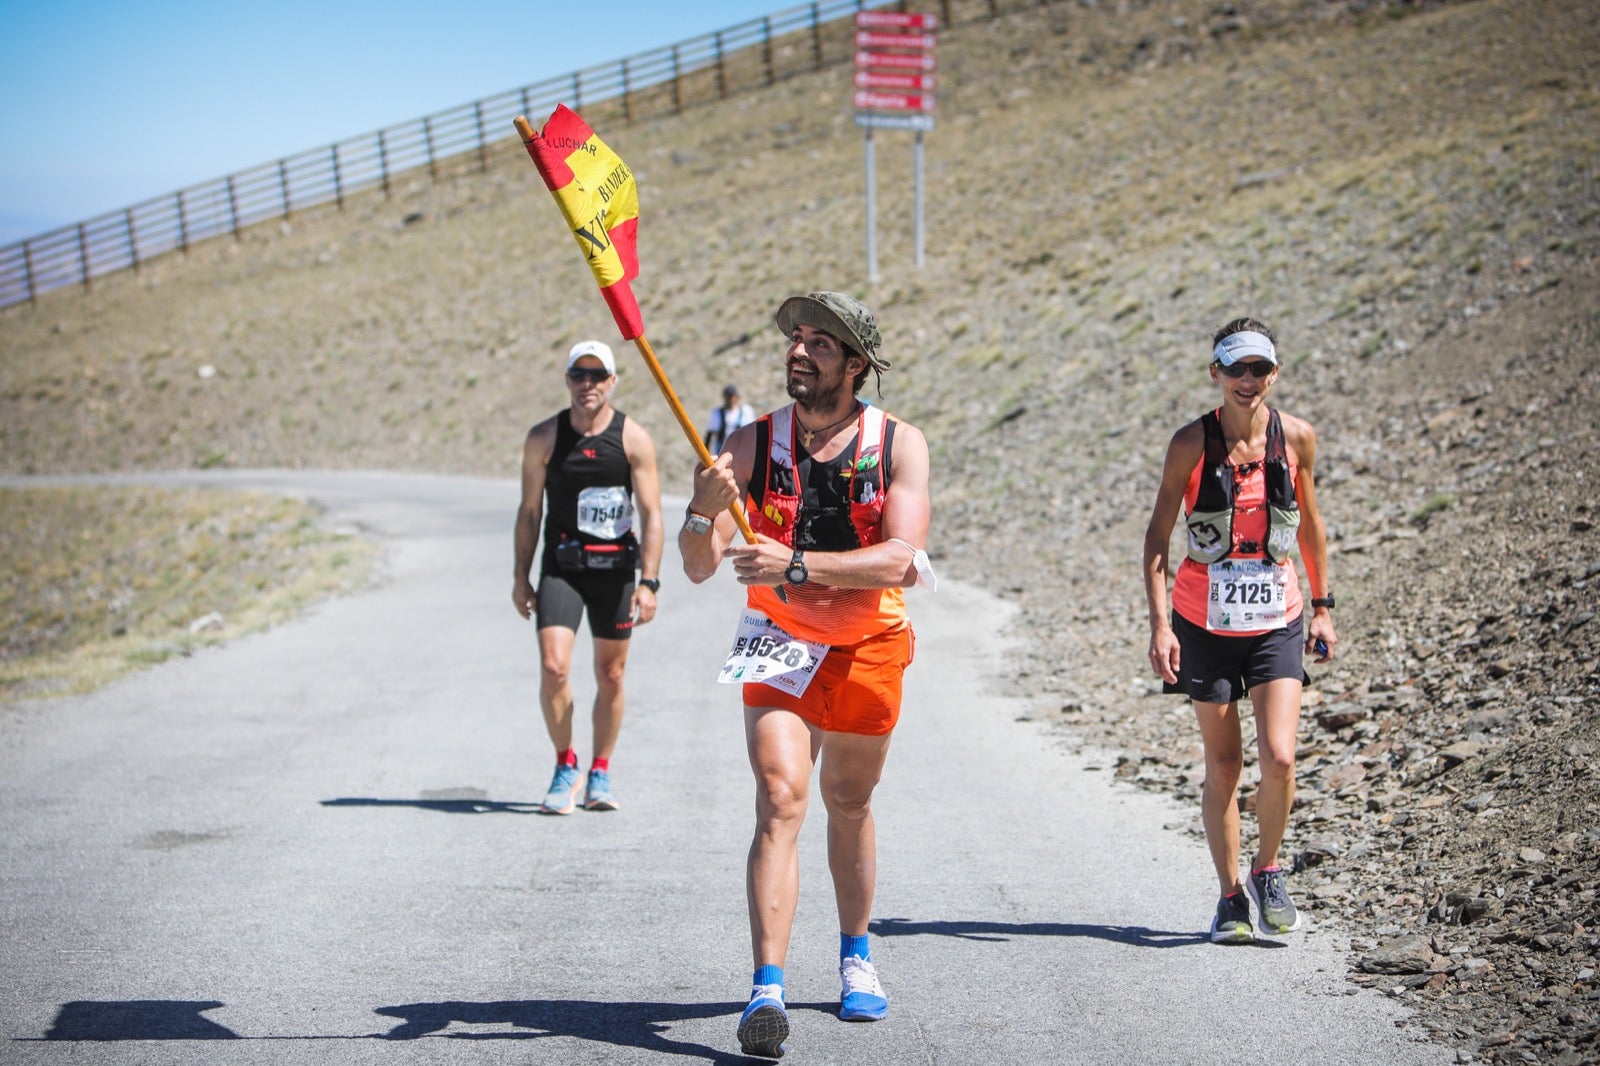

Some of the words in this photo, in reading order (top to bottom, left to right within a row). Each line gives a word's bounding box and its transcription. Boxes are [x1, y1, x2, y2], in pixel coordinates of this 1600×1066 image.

[553, 137, 597, 156] LUCHAR
[1225, 583, 1272, 604] 2125
[745, 637, 804, 668] 9528
